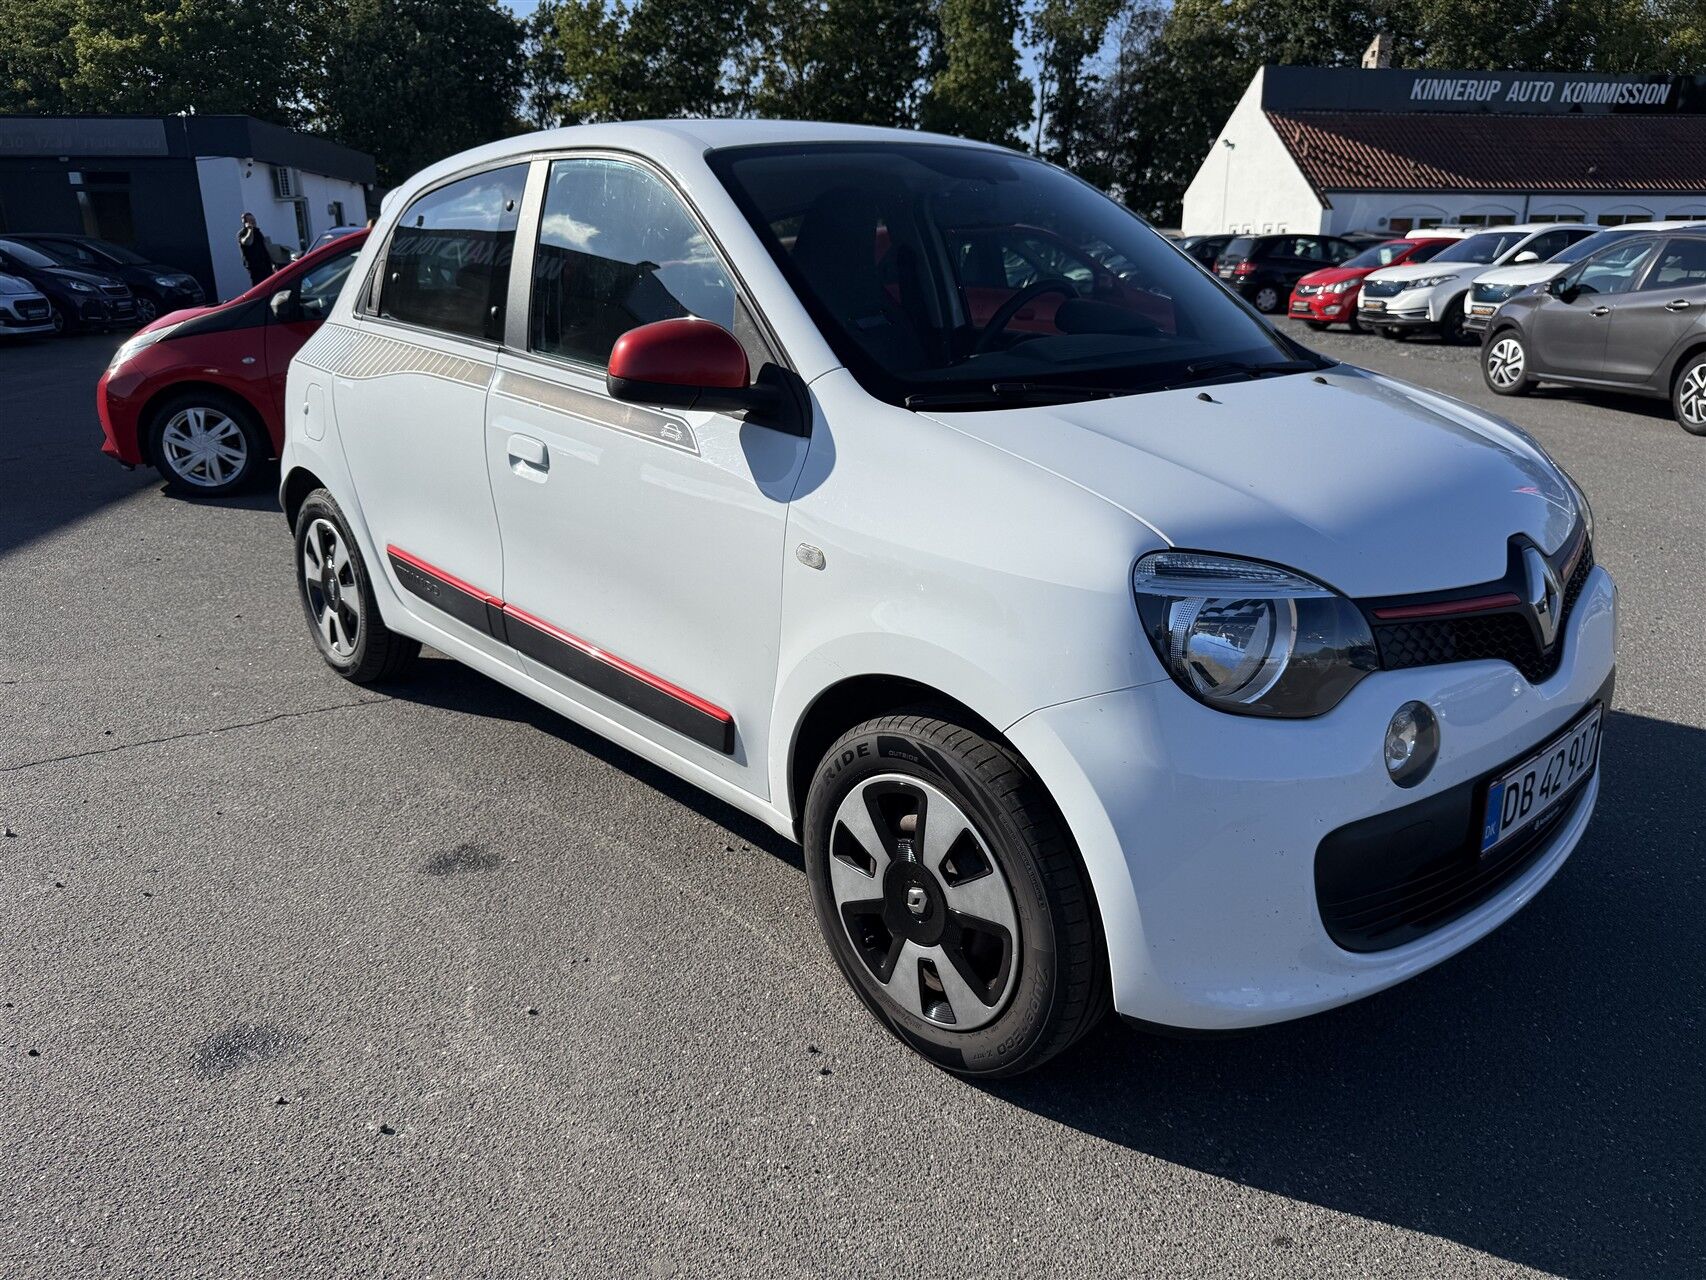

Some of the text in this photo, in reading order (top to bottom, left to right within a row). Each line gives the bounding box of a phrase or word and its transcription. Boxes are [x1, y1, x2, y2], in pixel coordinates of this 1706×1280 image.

[1410, 78, 1672, 105] KINNERUP AUTO KOMMISSION
[888, 750, 919, 762] OUTSIDE
[1501, 770, 1536, 831] DB
[1539, 749, 1566, 800] 42
[1567, 718, 1599, 781] 917
[1484, 821, 1497, 839] DK
